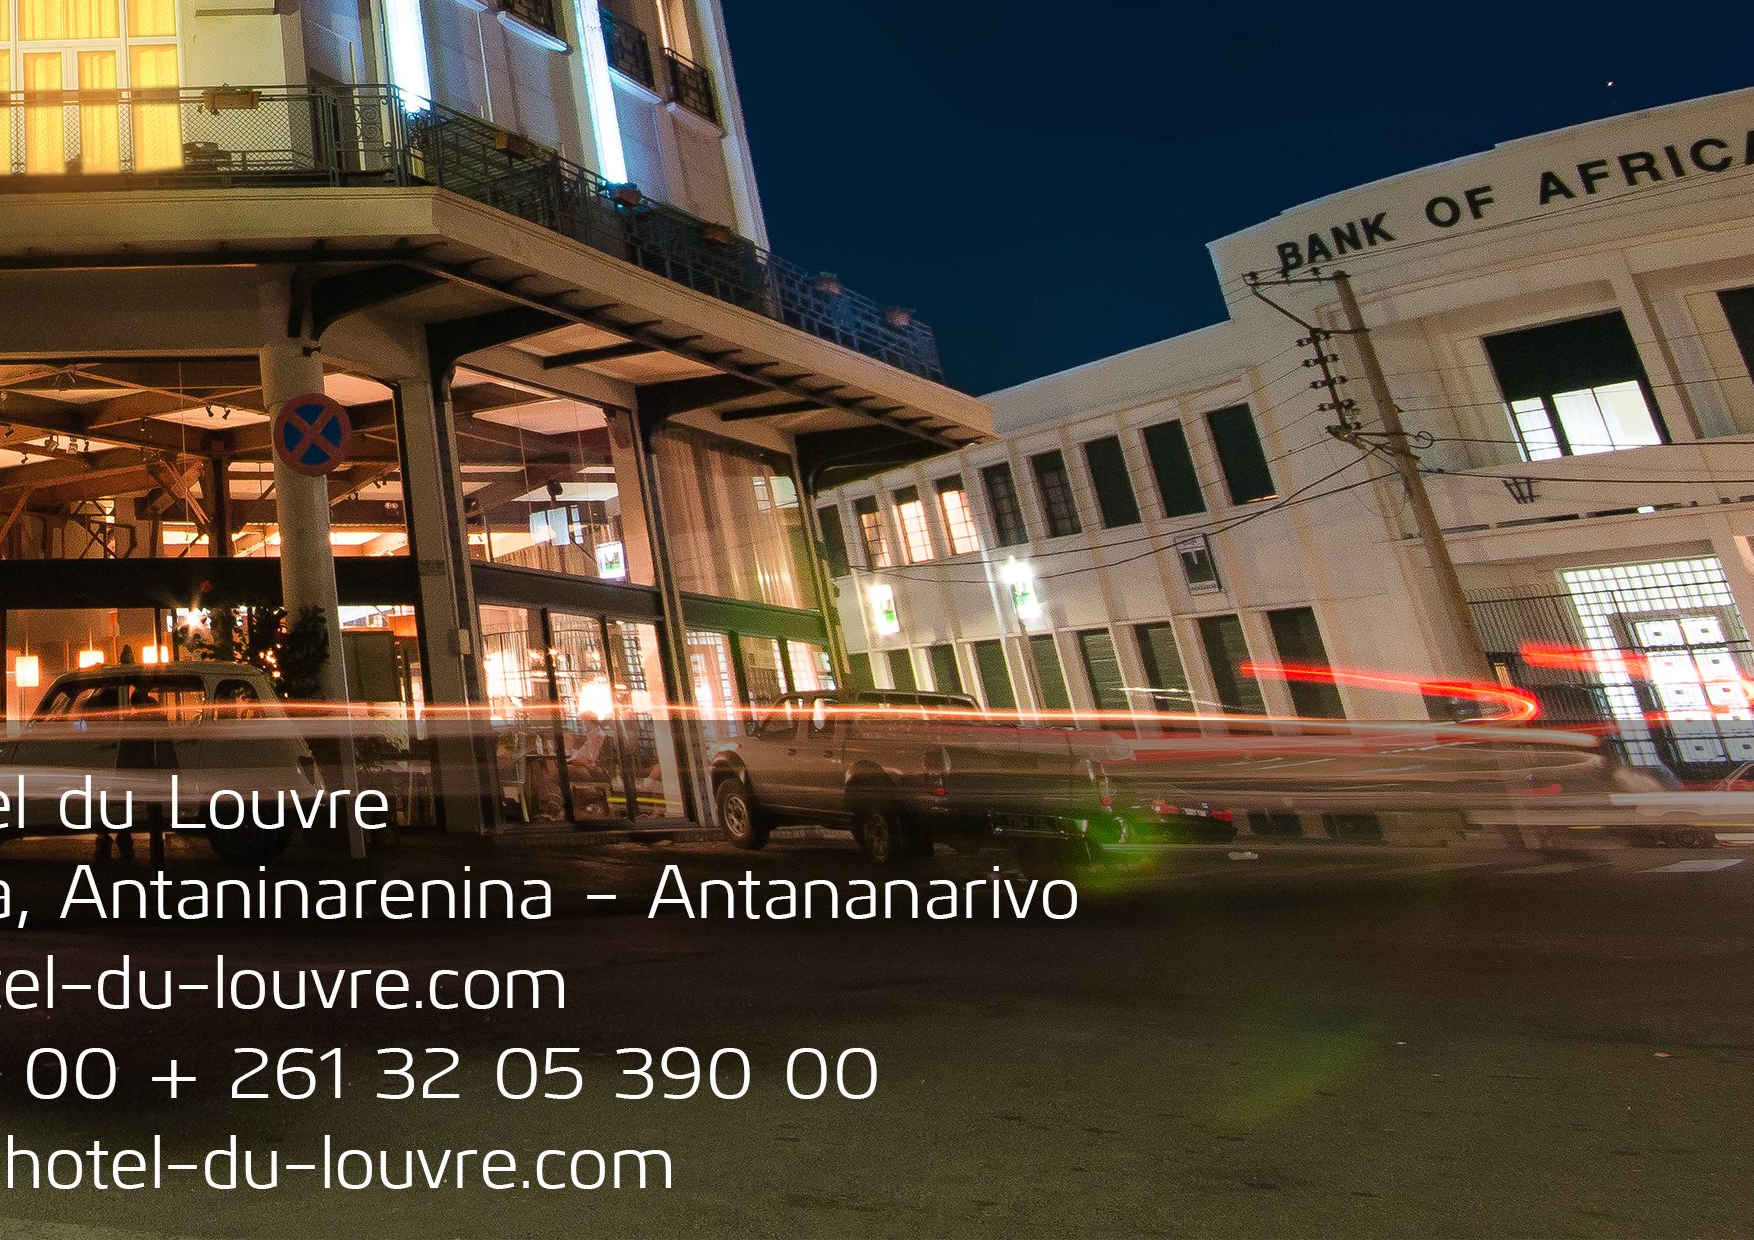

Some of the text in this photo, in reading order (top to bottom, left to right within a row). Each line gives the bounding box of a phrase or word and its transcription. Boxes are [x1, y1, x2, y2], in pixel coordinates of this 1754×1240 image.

[1276, 130, 1754, 270] BANK OF AFRIC
